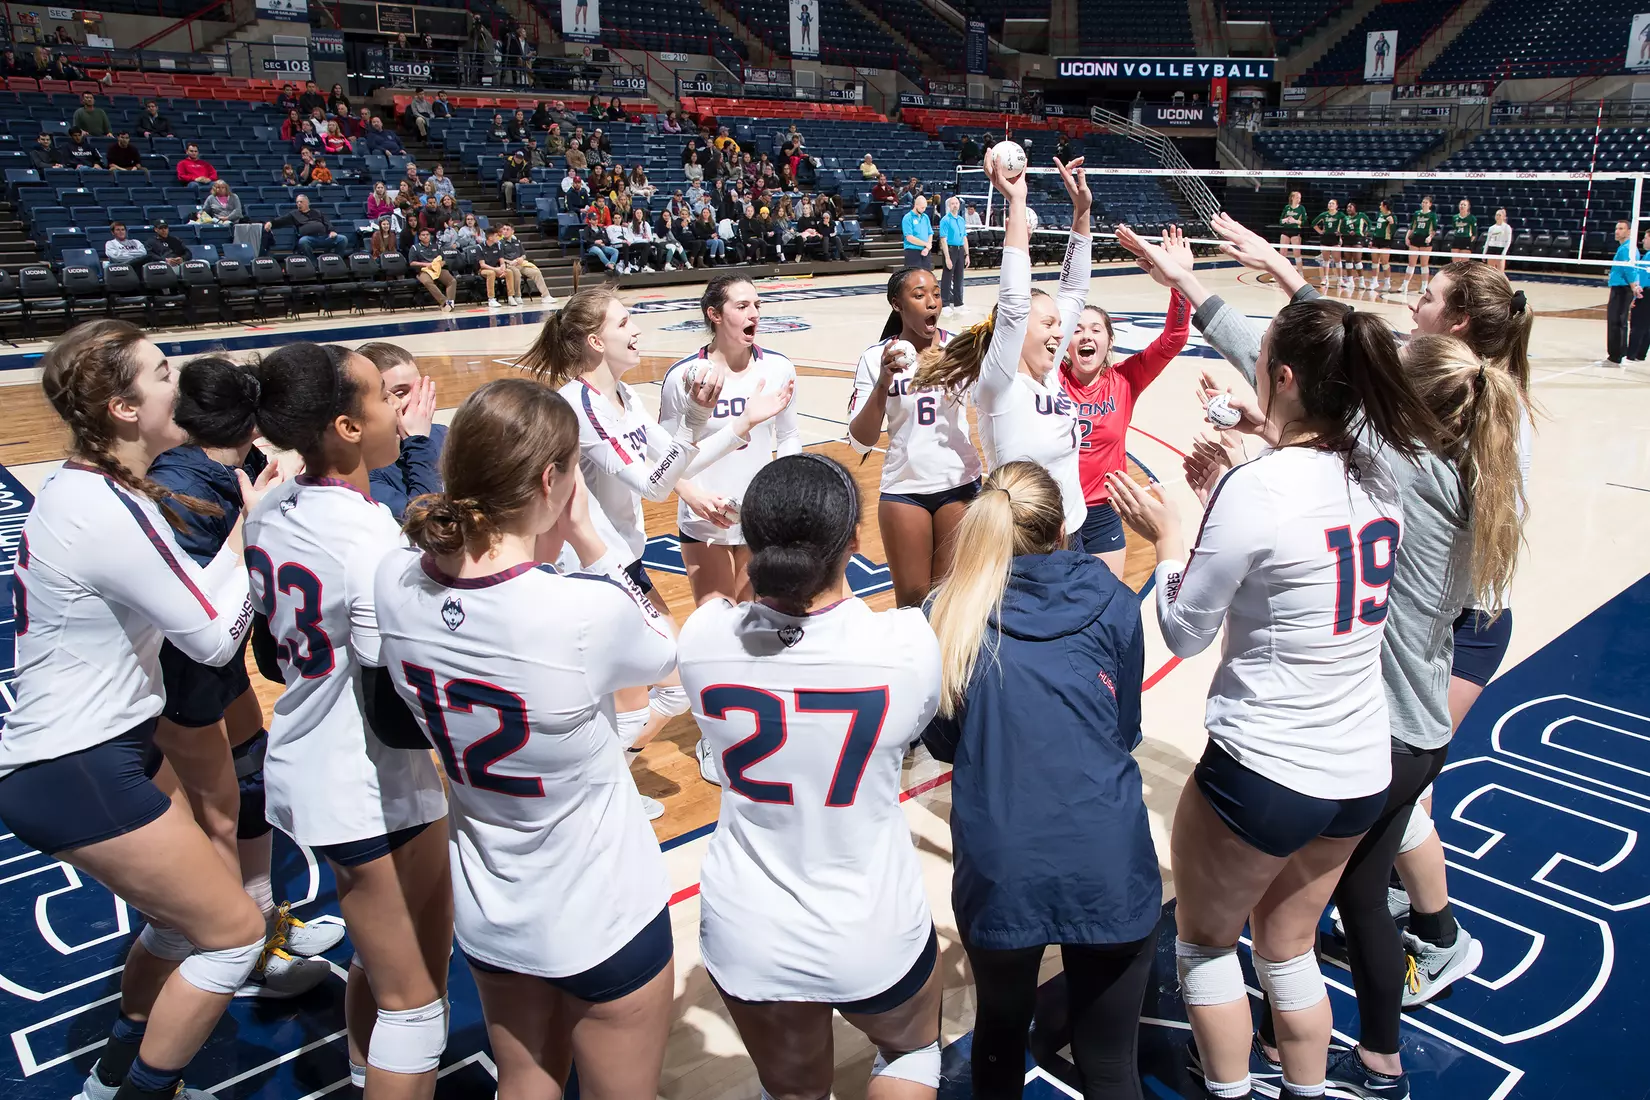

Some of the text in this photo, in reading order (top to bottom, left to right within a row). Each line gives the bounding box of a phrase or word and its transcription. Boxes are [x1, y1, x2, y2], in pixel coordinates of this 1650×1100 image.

[50, 9, 67, 17] SEC
[284, 60, 310, 72] 108
[407, 65, 430, 75] 109
[1060, 62, 1269, 77] UCONN VOLLEYBALL
[626, 79, 645, 88] 109
[696, 82, 712, 91] 110
[841, 90, 855, 99] 110
[913, 95, 924, 104] 111
[1157, 109, 1203, 120] UCONN
[1061, 241, 1076, 283] HUSKIES
[917, 396, 936, 426] 6
[1072, 396, 1116, 416] ONN
[649, 447, 679, 484] HUSKIES
[1324, 517, 1401, 636] 19
[244, 545, 336, 680] 23
[401, 660, 546, 798] 12
[700, 683, 889, 808] 27
